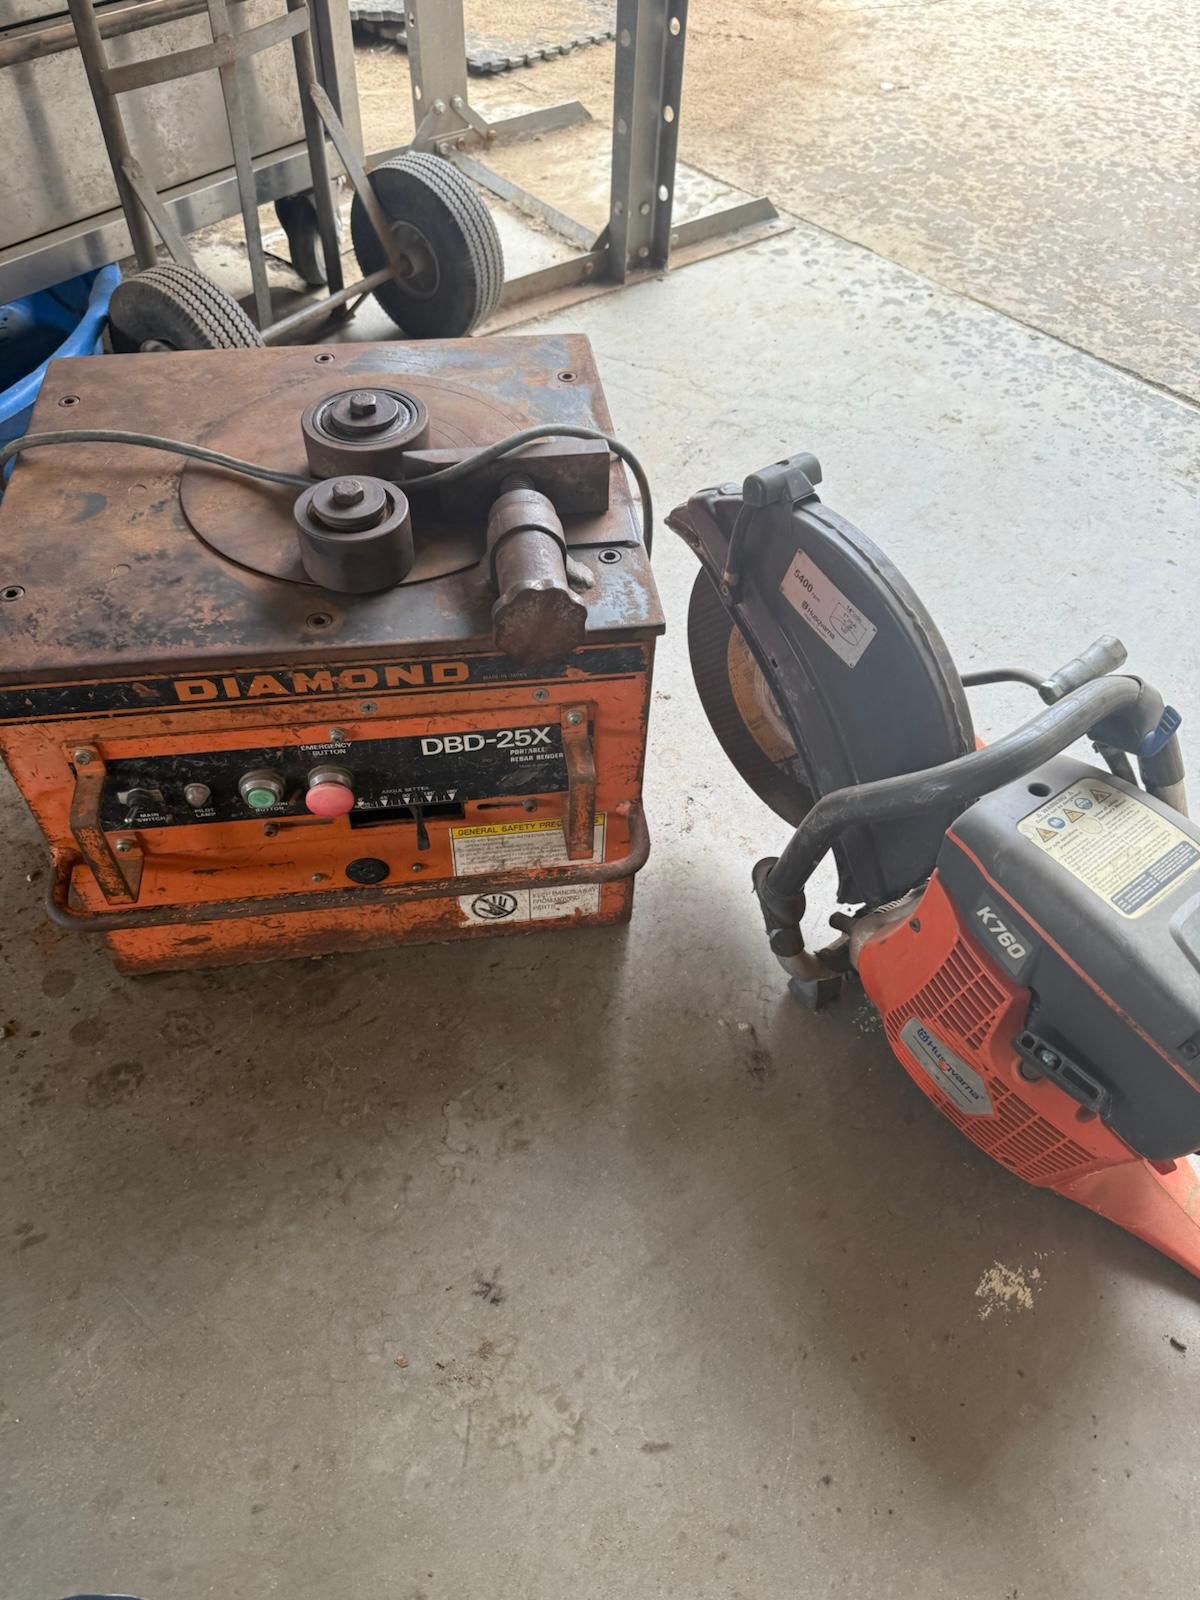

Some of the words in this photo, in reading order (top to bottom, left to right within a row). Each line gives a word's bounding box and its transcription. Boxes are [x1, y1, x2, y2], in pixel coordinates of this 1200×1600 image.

[793, 568, 814, 593] 5400
[173, 661, 470, 702] DIAMOND
[300, 742, 352, 751] EMERGENCY
[420, 726, 553, 757] DBD-25X
[312, 749, 347, 757] BUTTON
[510, 747, 545, 755] PORTABLE
[510, 755, 534, 763] REBAR
[536, 752, 564, 760] BENDER
[457, 827, 498, 837] GENERAL
[501, 823, 536, 834] SAFETY
[976, 905, 1026, 959] K760
